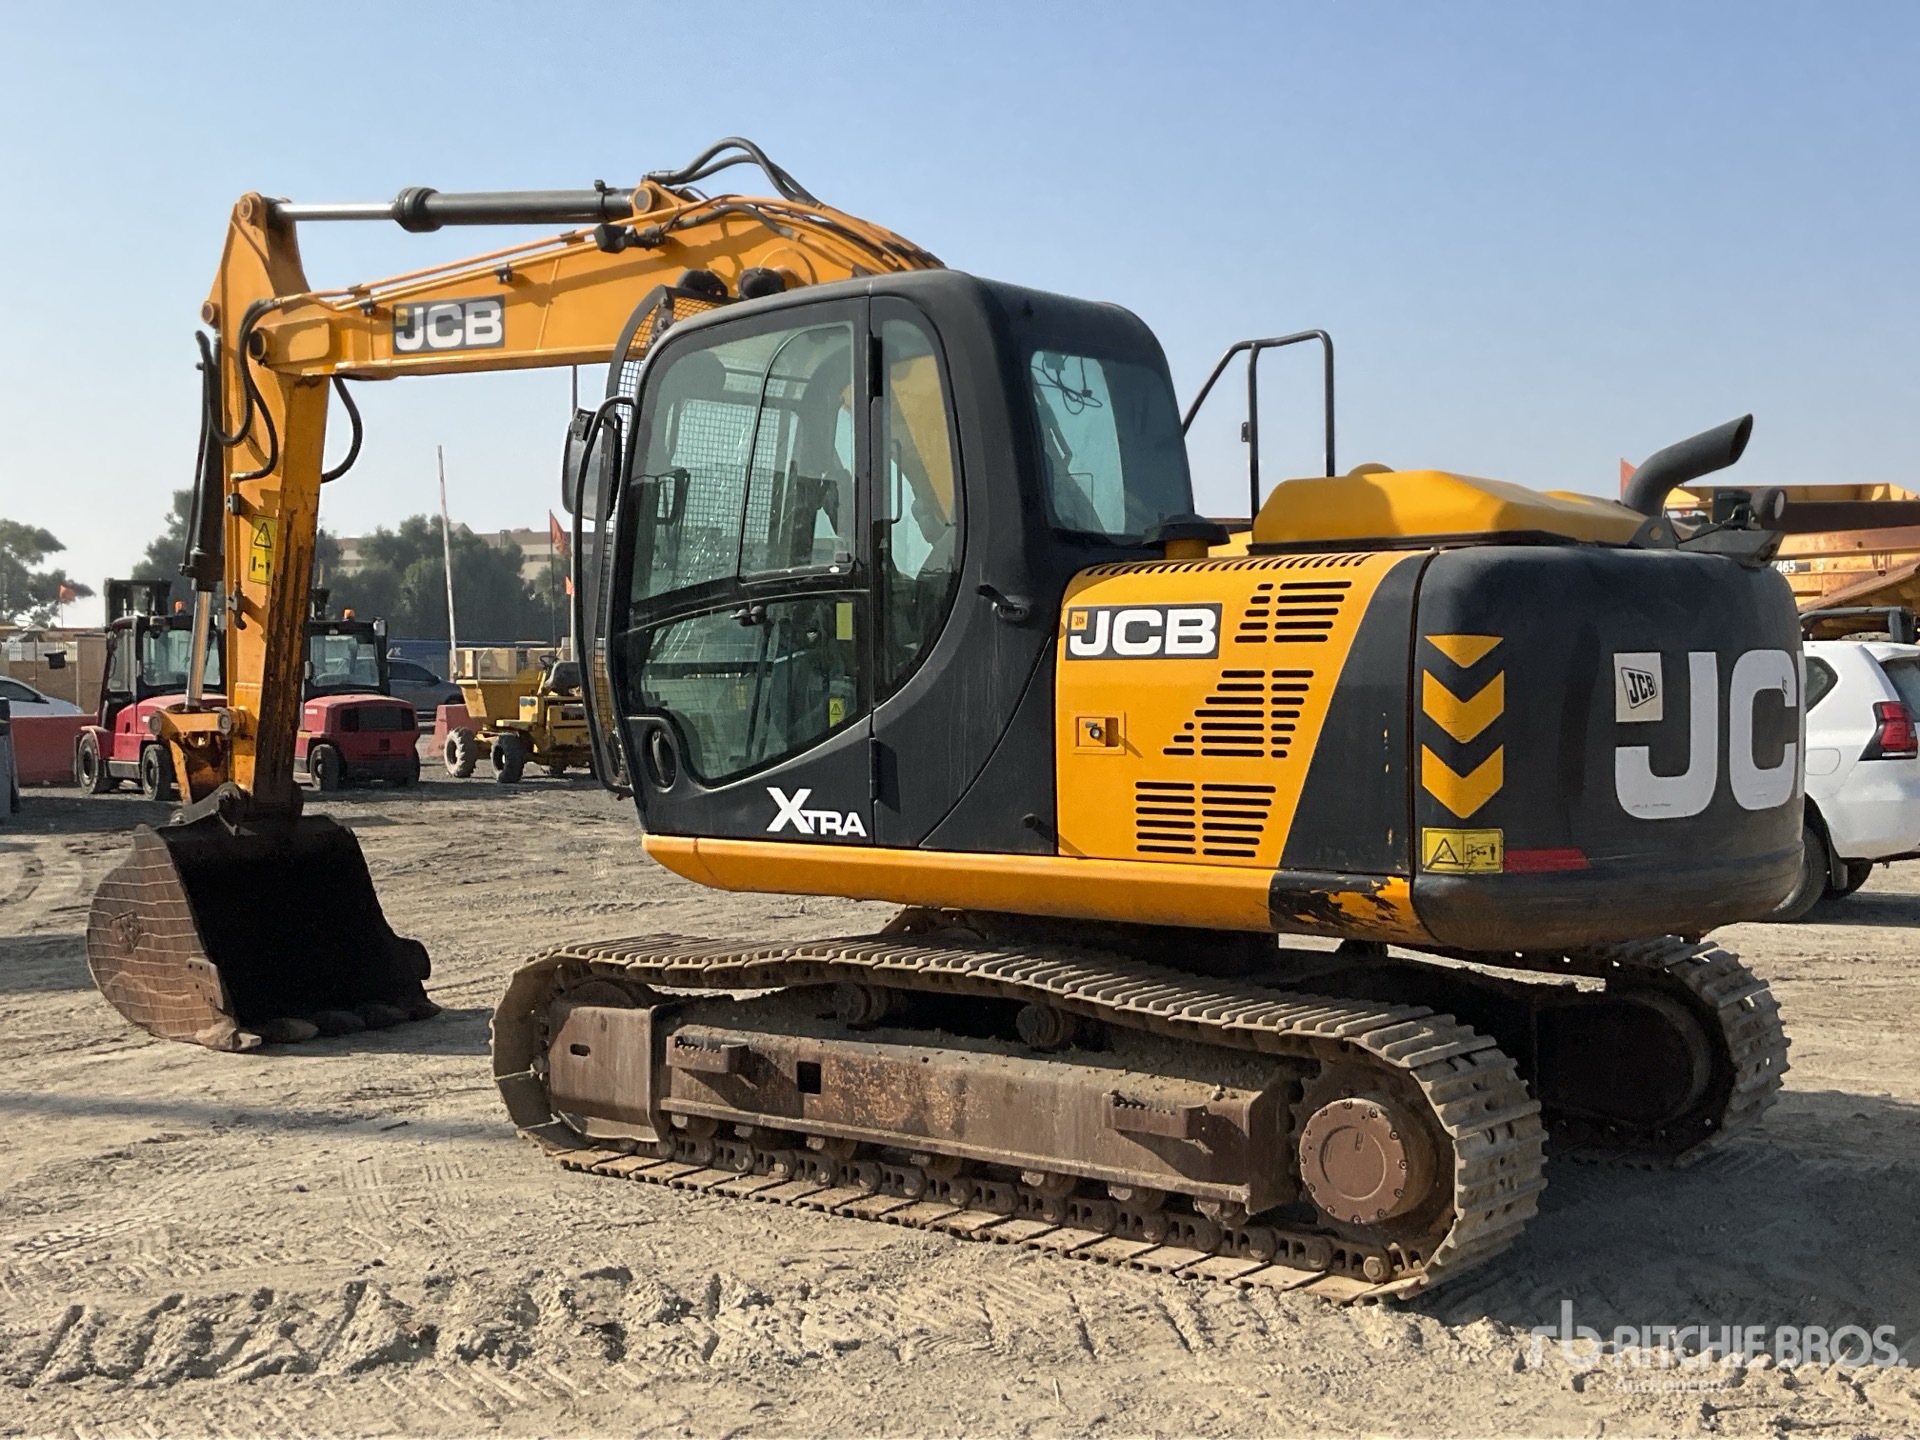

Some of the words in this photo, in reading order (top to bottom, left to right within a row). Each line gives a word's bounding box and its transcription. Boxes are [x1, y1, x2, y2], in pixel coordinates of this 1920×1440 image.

[396, 301, 502, 351] JCB
[1070, 608, 1216, 656] JCB
[1628, 671, 1655, 704] JCB
[1614, 649, 1807, 820] JC
